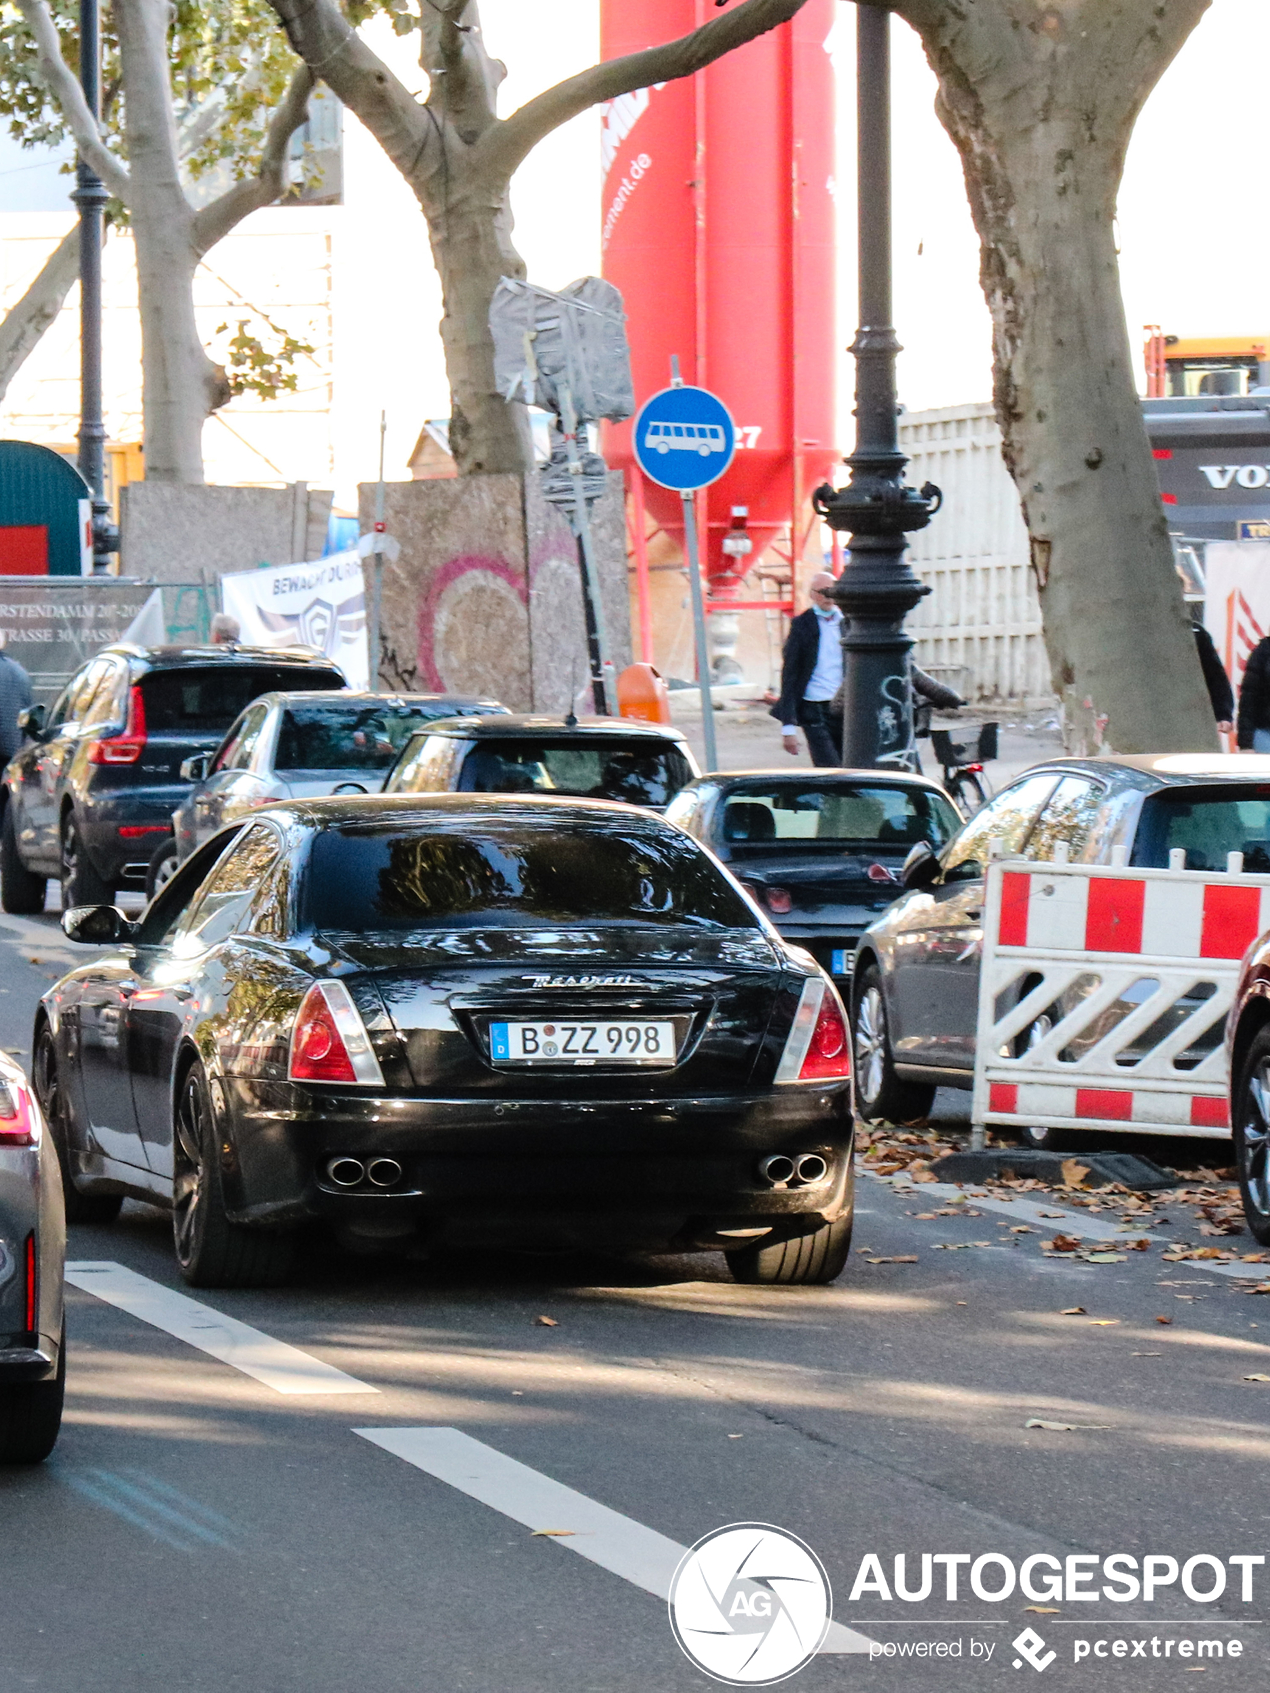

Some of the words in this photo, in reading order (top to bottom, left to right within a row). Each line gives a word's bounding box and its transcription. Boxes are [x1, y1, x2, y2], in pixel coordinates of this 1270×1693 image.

[1198, 465, 1270, 489] VO
[272, 569, 327, 595] BEWACHT
[521, 1027, 539, 1054] B
[561, 1026, 599, 1054] ZZ
[606, 1026, 661, 1054] 998
